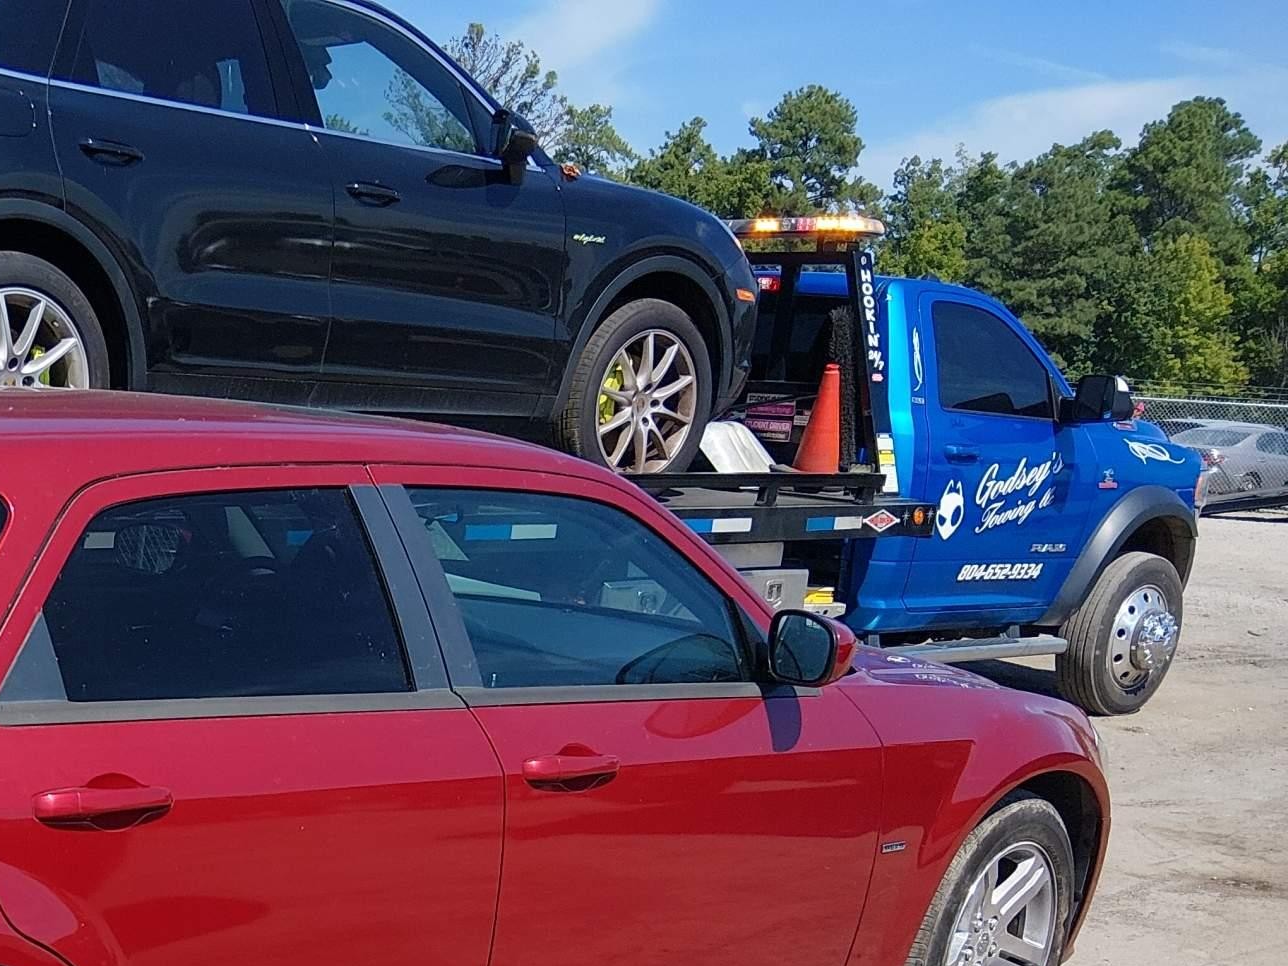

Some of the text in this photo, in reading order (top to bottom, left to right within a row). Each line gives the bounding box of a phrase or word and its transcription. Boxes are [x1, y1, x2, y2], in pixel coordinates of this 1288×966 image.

[975, 452, 1064, 508] Godsey's
[974, 499, 1036, 534] Towing
[957, 563, 1044, 582] 804-652-9334
